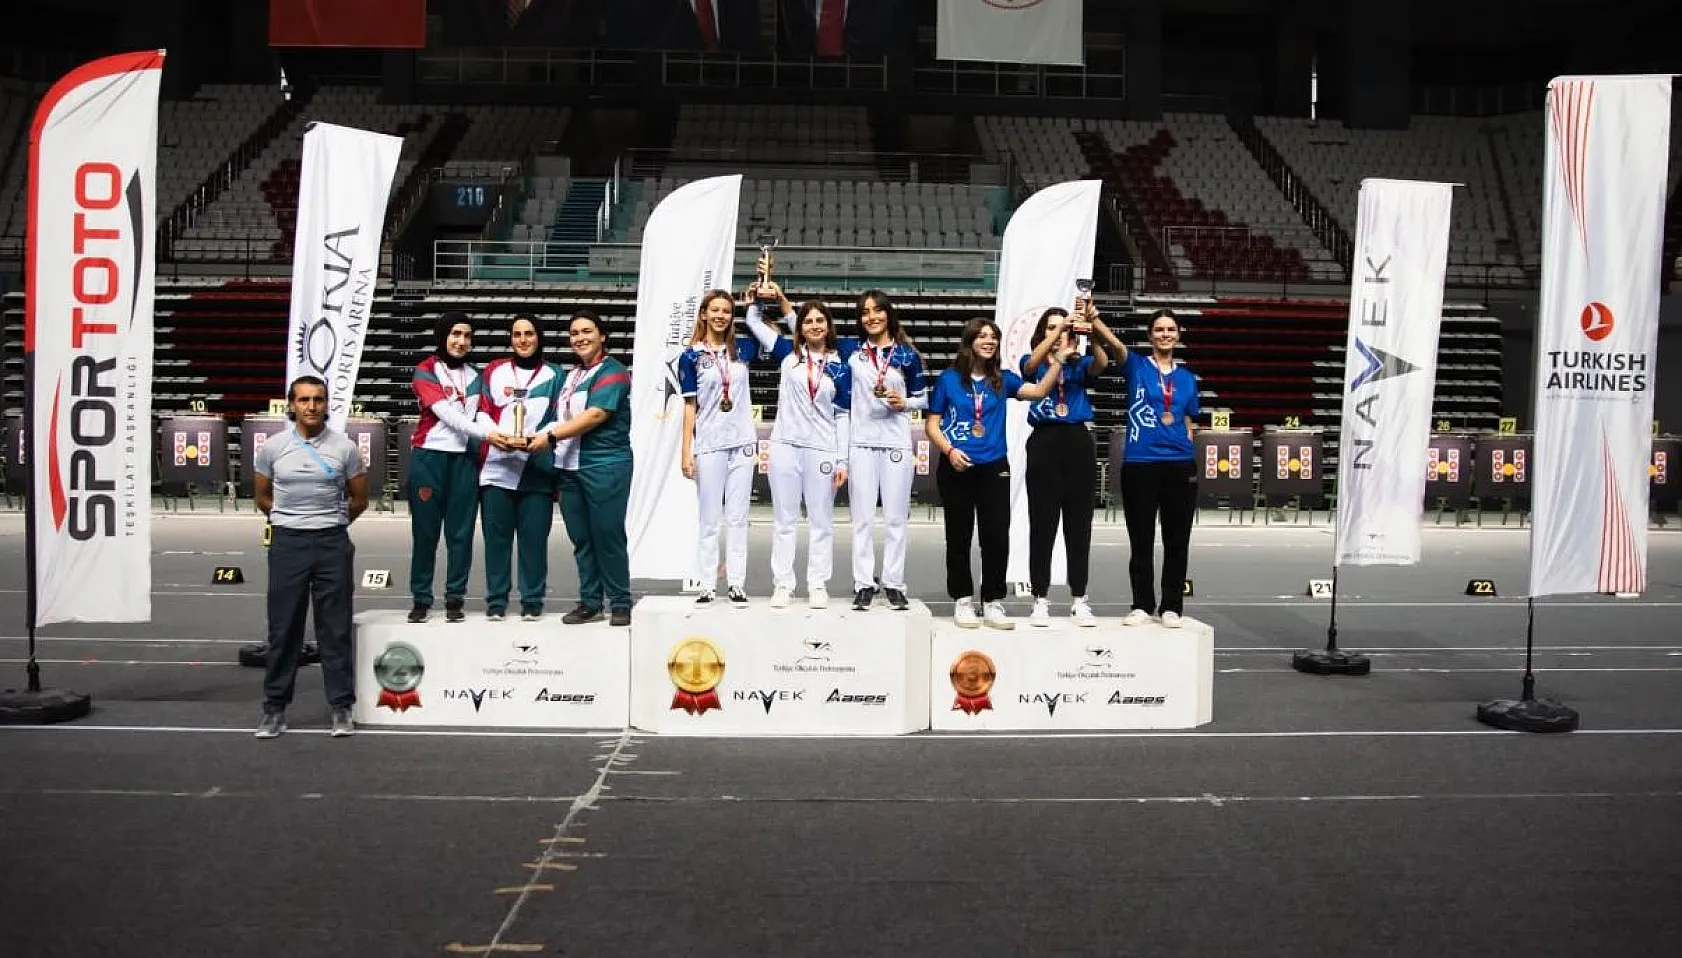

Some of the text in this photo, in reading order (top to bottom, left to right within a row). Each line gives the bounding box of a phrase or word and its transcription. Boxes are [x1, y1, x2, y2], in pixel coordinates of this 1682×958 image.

[457, 186, 484, 206] 210
[307, 224, 360, 380] ORIA
[331, 268, 373, 414] SPORTS ARENA
[1351, 254, 1421, 469] NAVEK
[1547, 351, 1647, 371] TURKISH
[1547, 372, 1647, 392] AIRLINES
[190, 400, 205, 412] 10
[1214, 415, 1228, 427] 23
[1285, 415, 1300, 428] 24
[216, 569, 235, 581] 14
[368, 573, 384, 585] 15
[1314, 583, 1332, 594] 21
[1473, 582, 1493, 593] 22
[443, 689, 513, 714] NAVEK
[534, 687, 596, 702] Aases
[733, 689, 804, 715] NAVEK
[826, 687, 887, 703] Aases
[1107, 690, 1166, 704] Aases
[1019, 692, 1087, 718] NAVEK
